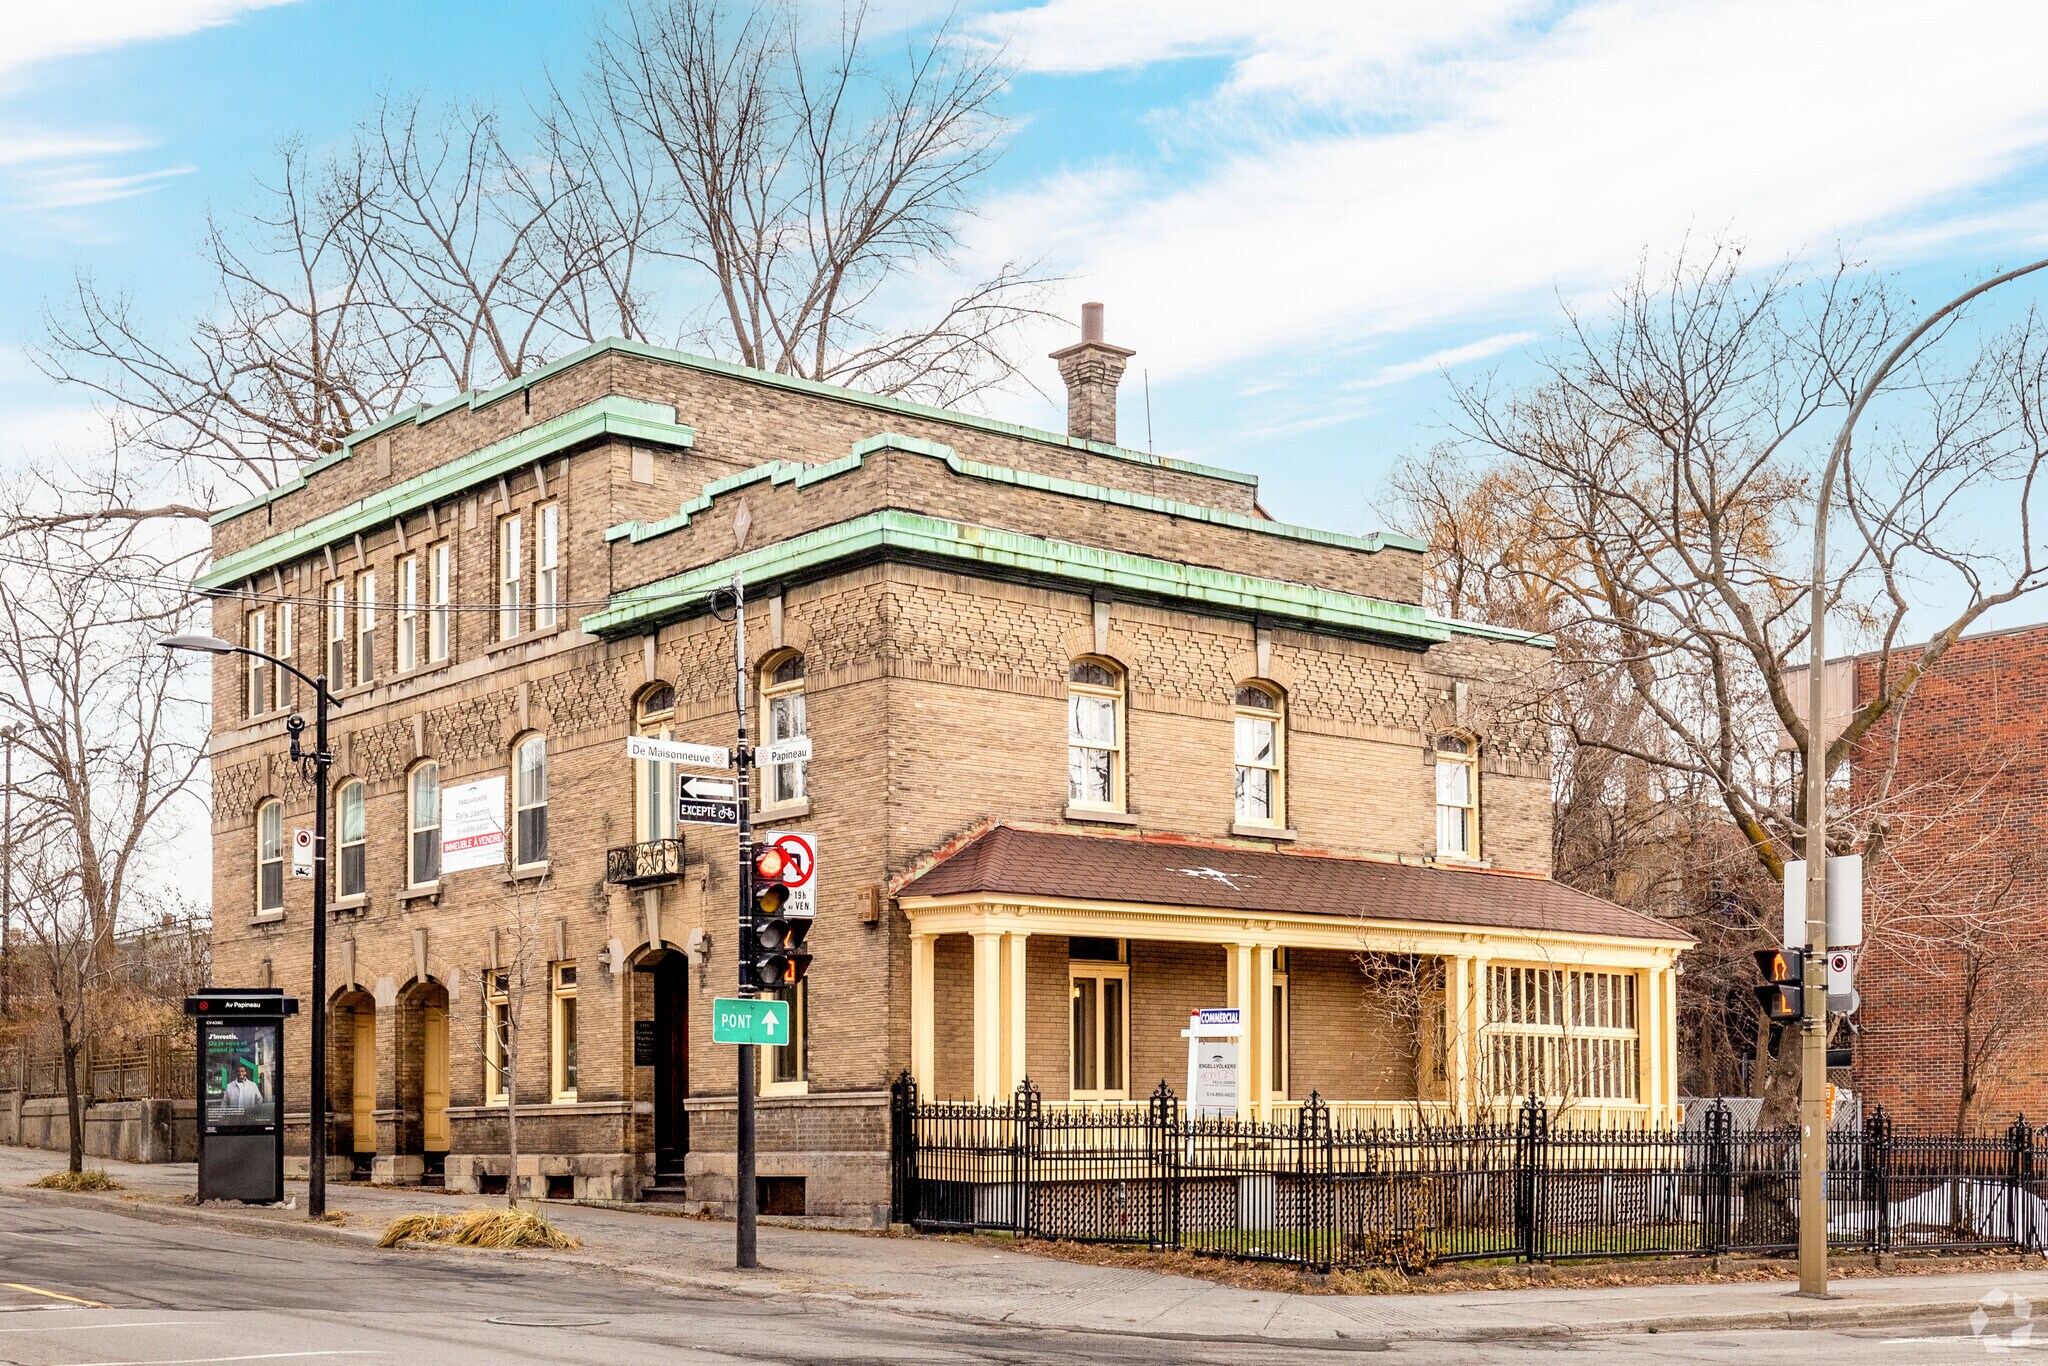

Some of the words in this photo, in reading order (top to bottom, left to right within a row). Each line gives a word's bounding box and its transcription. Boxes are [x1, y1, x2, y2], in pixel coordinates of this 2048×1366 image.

[632, 744, 646, 755] De
[648, 746, 711, 763] Maisonneuve
[771, 749, 807, 762] Papineau
[681, 803, 717, 818] EXCEPTÉ
[444, 839, 473, 852] IMMEUBLE
[473, 836, 479, 847] À
[479, 833, 503, 846] VENDRE
[794, 890, 807, 900] 19h
[795, 901, 813, 911] VEN.
[721, 1013, 752, 1029] PONT
[1201, 1012, 1240, 1024] COMMERCIAL
